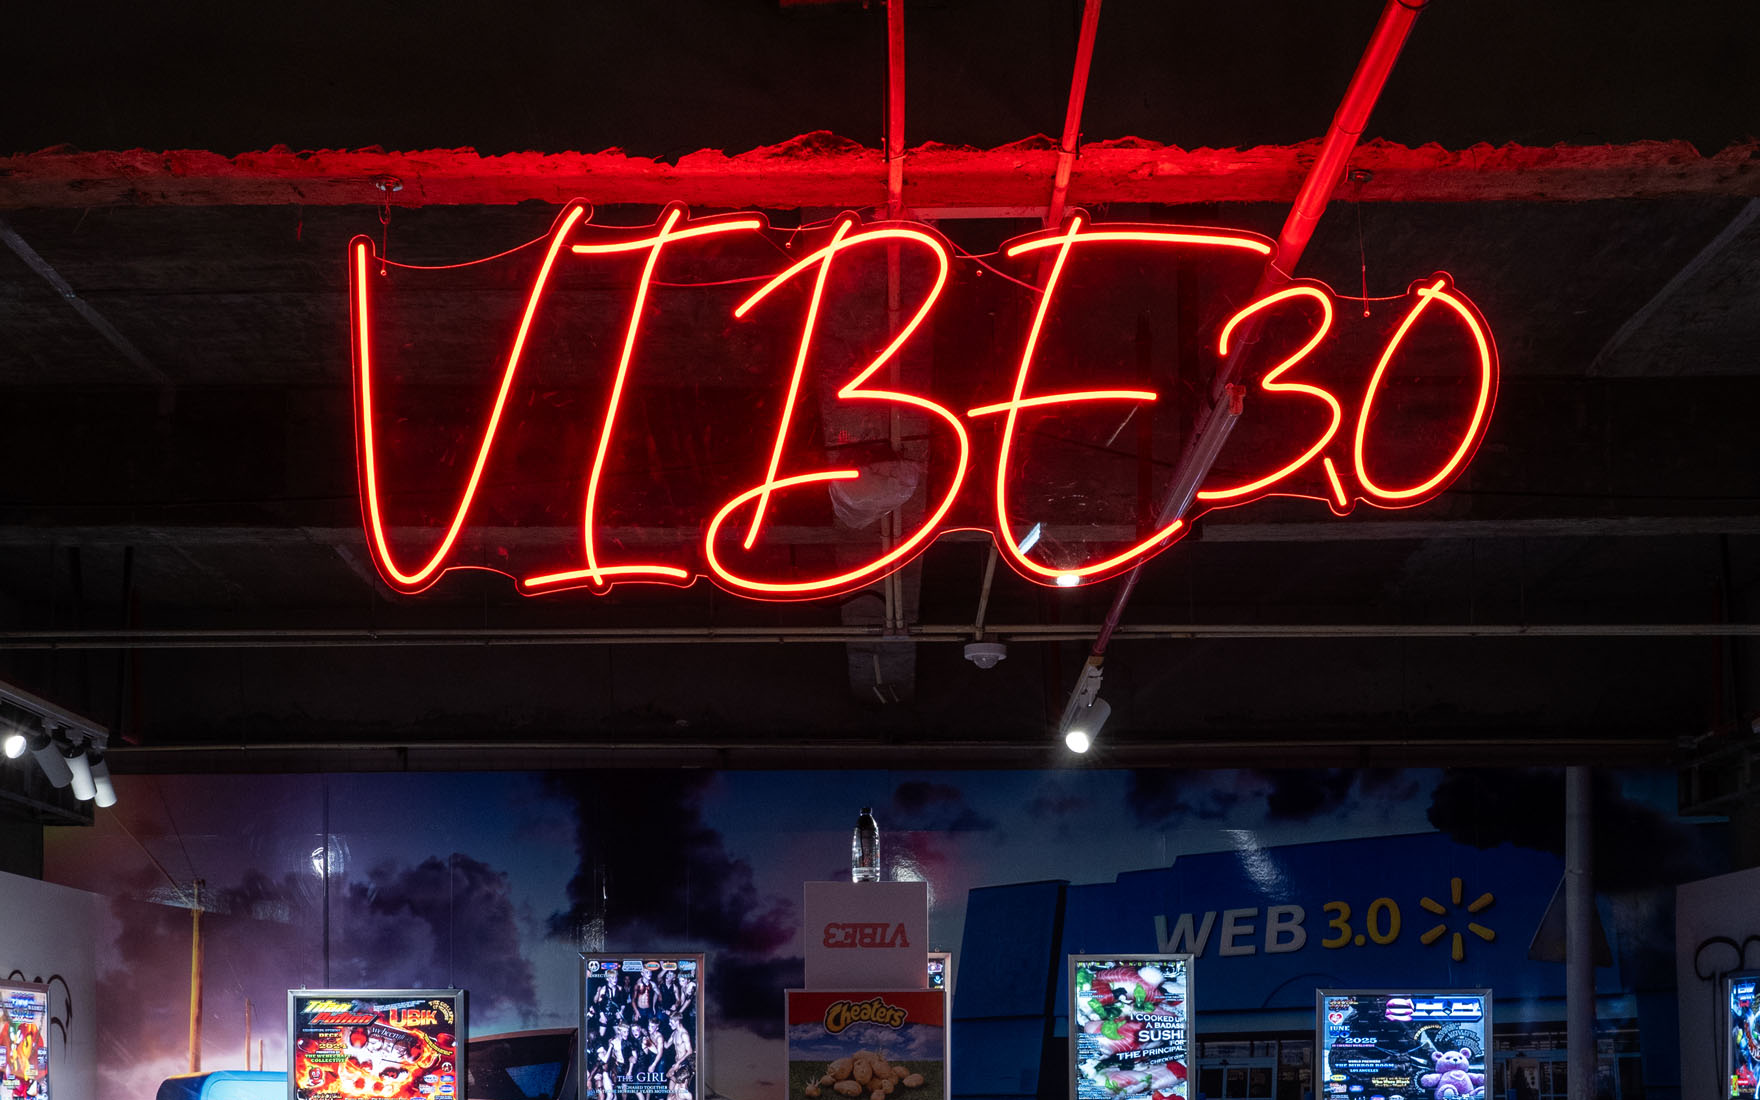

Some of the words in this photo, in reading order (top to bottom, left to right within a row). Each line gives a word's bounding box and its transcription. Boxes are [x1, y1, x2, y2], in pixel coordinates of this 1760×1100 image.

[350, 204, 1277, 594] VIBE
[1193, 276, 1498, 511] 3.0
[823, 922, 911, 949] VIBE3
[1154, 904, 1308, 958] WEB
[1321, 897, 1401, 949] 3.0
[389, 1004, 438, 1028] UBIK
[824, 997, 908, 1035] Cheaters
[1136, 1013, 1174, 1023] COOKED
[1138, 1029, 1185, 1042] SUSHI
[1116, 1050, 1141, 1061] THE
[617, 1075, 633, 1083] THE
[636, 1072, 668, 1083] GIRL
